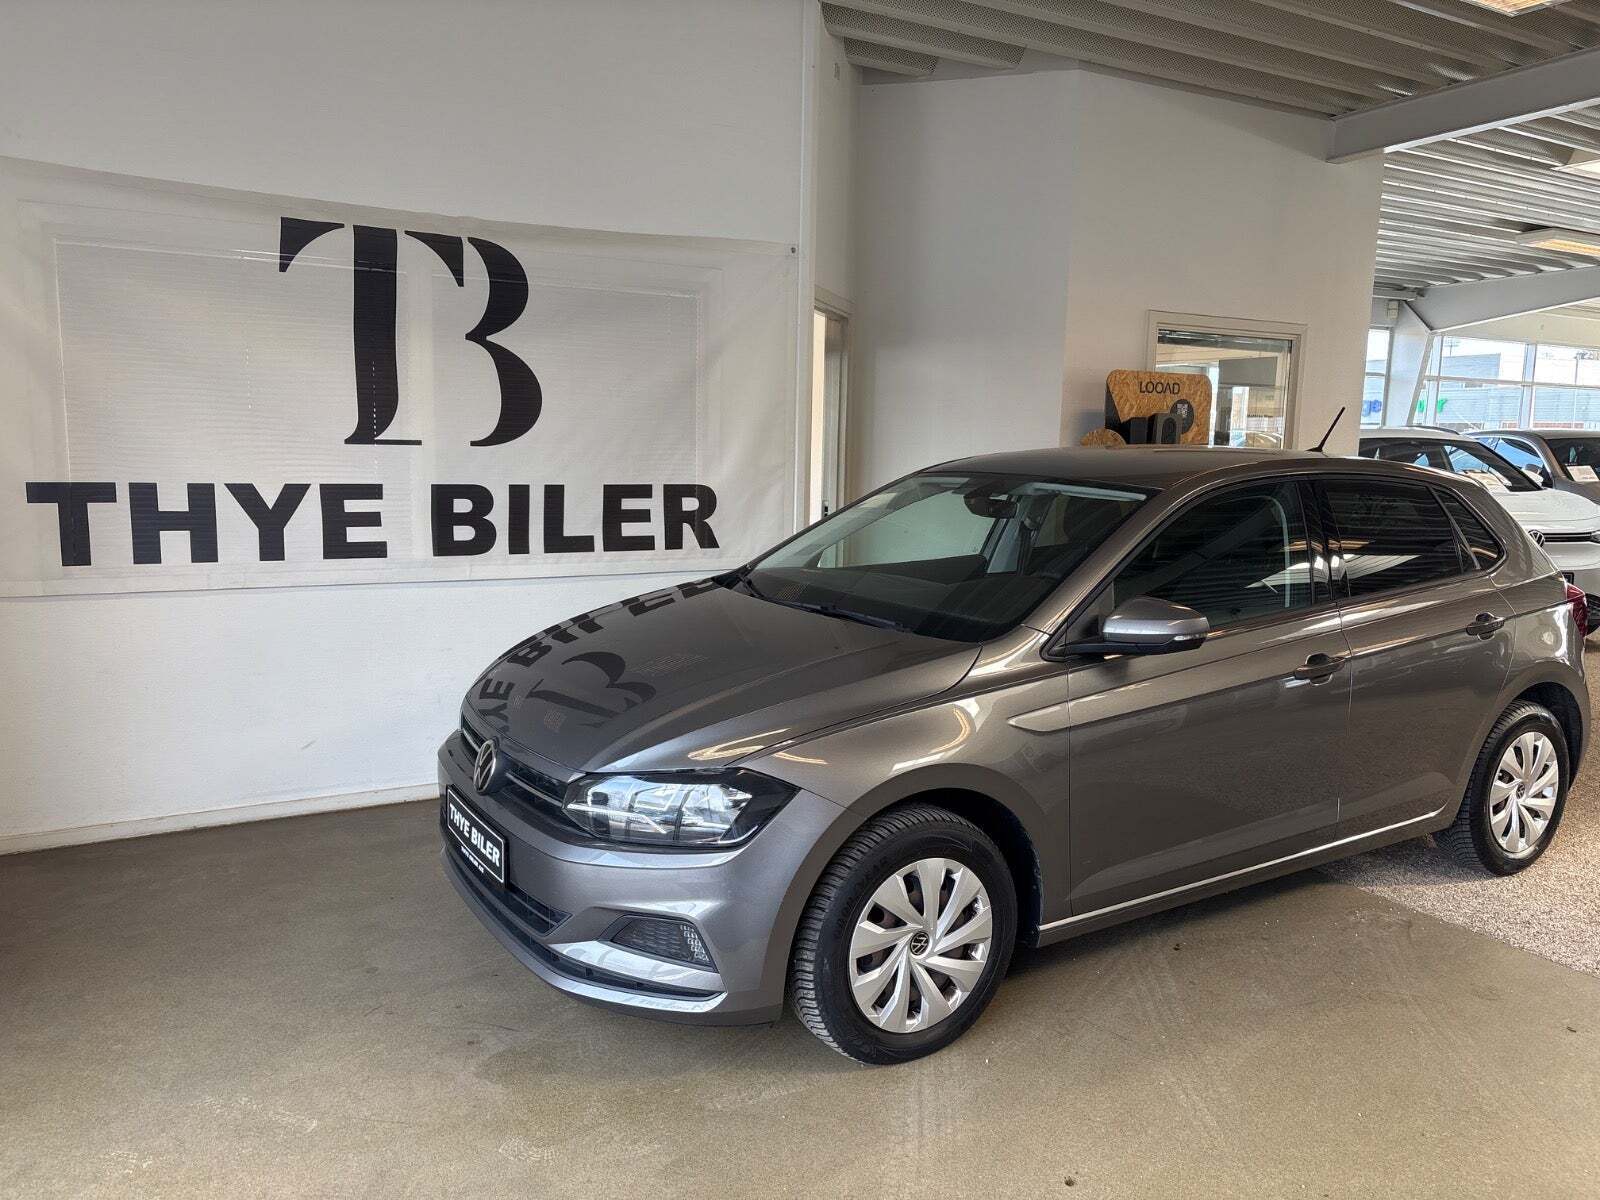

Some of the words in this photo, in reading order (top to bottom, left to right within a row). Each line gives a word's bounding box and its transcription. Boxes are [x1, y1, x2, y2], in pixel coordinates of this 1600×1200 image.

[26, 482, 388, 567] THYE
[431, 483, 720, 557] BILER
[449, 802, 470, 838] THYE
[471, 826, 500, 867] BILER
